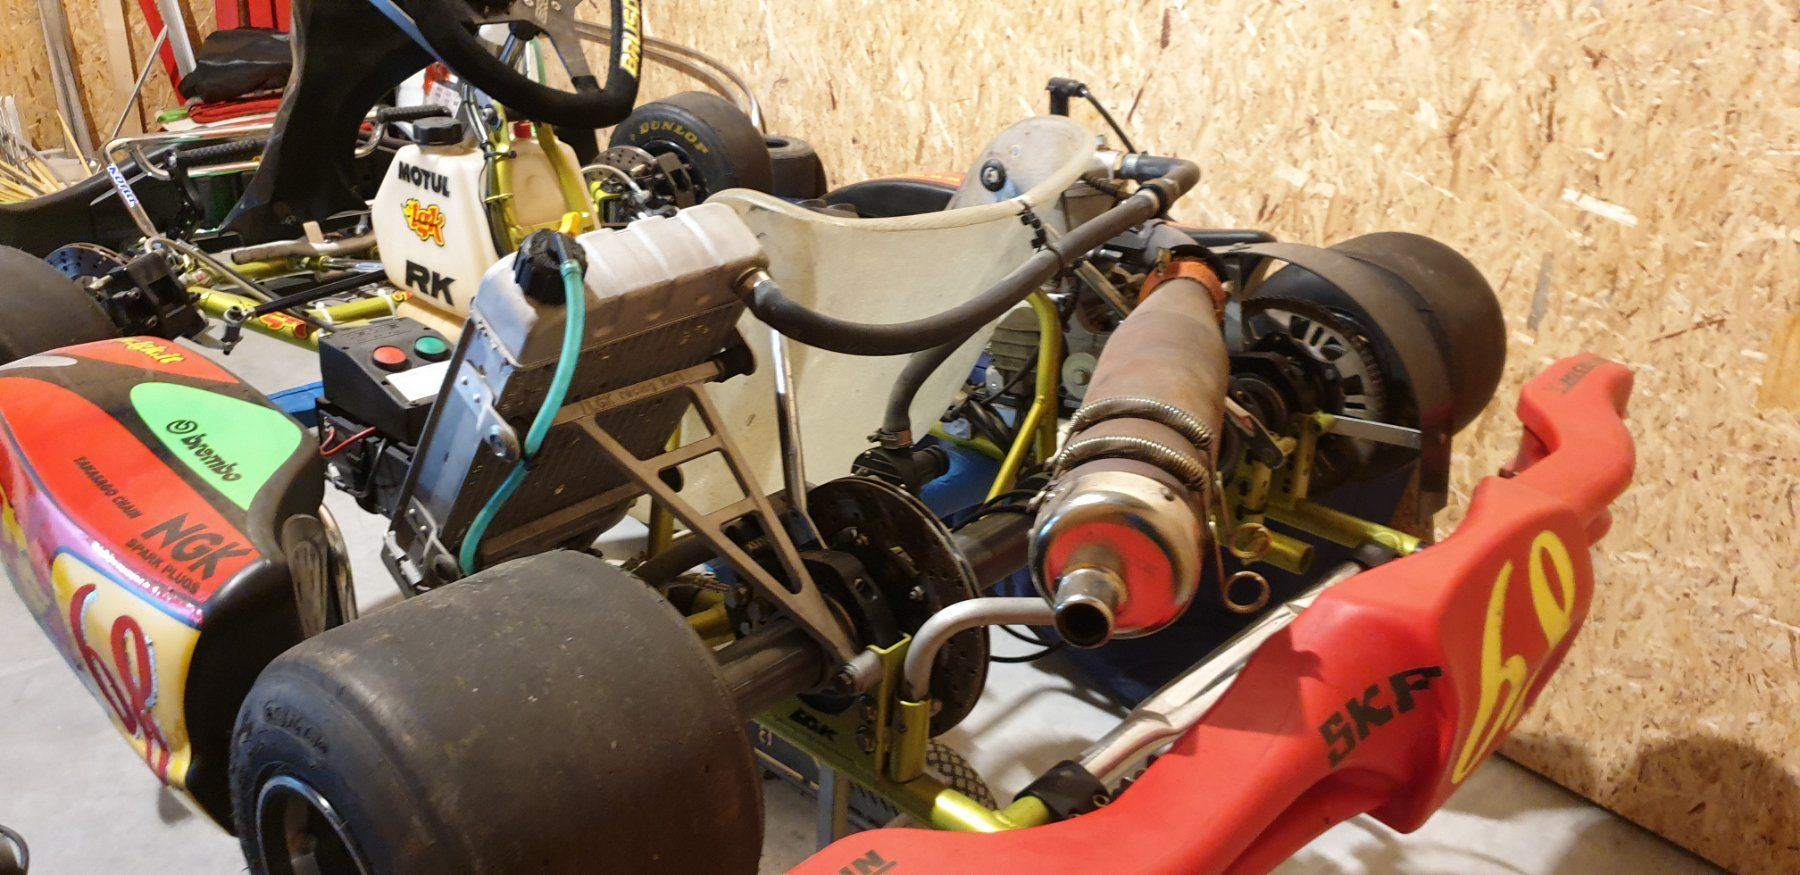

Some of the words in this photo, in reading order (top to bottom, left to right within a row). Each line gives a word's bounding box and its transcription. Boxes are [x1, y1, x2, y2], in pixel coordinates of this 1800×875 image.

[640, 120, 709, 154] DUNLOP
[398, 160, 450, 197] MOTUL
[405, 259, 456, 307] RK
[180, 433, 243, 481] brembo
[112, 496, 143, 520] CHAIN
[125, 538, 162, 569] SPARK
[161, 564, 201, 595] PLUGS
[141, 512, 252, 581] NGK
[1319, 666, 1443, 769] SKF
